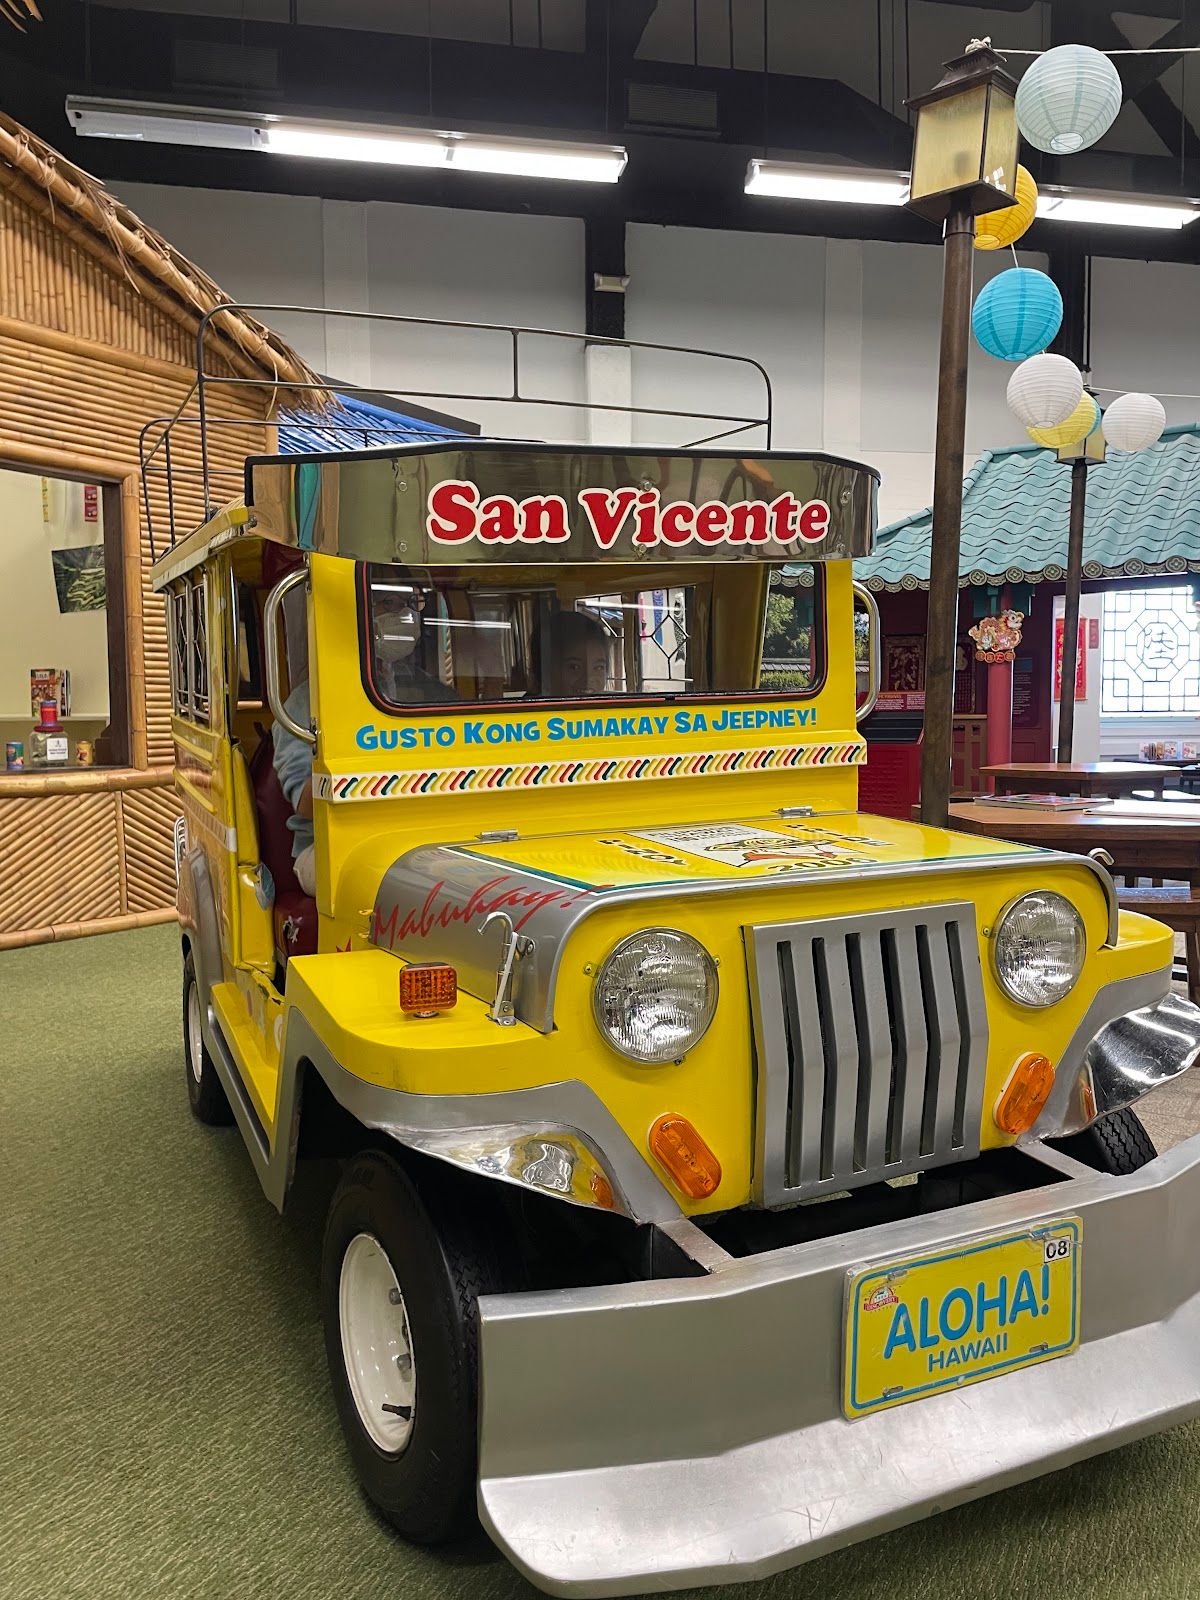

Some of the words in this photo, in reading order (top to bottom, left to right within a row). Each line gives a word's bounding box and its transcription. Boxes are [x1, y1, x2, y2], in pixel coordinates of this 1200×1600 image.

[426, 479, 571, 546] San
[577, 486, 831, 550] Vicente
[355, 720, 456, 751] GUSTO
[463, 720, 540, 744] KONG
[546, 714, 670, 741] SUMAKAY
[674, 710, 709, 734] SA
[711, 707, 818, 732] JEEPNEY!
[597, 838, 689, 867] PINOY
[373, 874, 616, 950] Mabuhay!
[1045, 1239, 1069, 1260] 08
[883, 1263, 1050, 1360] ALOHA!
[927, 1332, 1008, 1373] HAWAII
